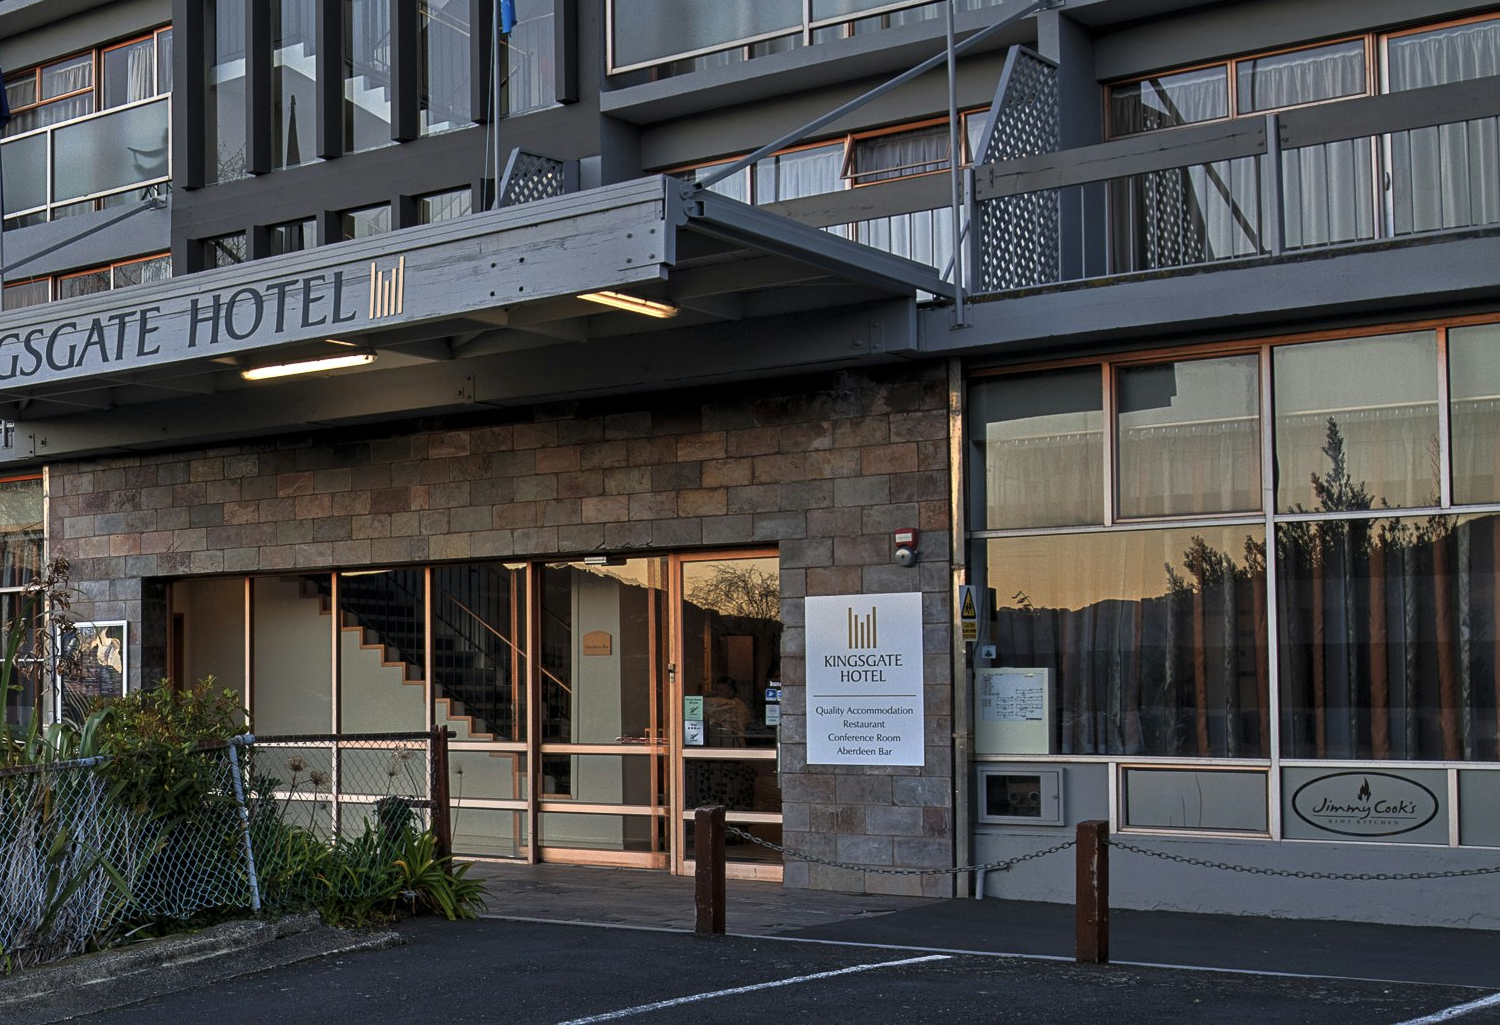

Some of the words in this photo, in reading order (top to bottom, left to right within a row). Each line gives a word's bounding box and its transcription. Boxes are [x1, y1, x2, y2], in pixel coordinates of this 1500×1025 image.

[188, 271, 357, 349] HOTEL
[824, 654, 903, 668] KINGSGATE
[840, 670, 887, 683] HOTEL
[815, 706, 845, 716] Quality
[846, 706, 914, 715] Accommodation
[843, 720, 885, 728] Restaurant
[828, 733, 875, 742] Conference
[876, 733, 901, 742] Room
[836, 747, 876, 756] Aberdeen
[878, 747, 893, 756] Bar
[1312, 797, 1371, 819] Jimmy
[1374, 800, 1418, 814] Cook's
